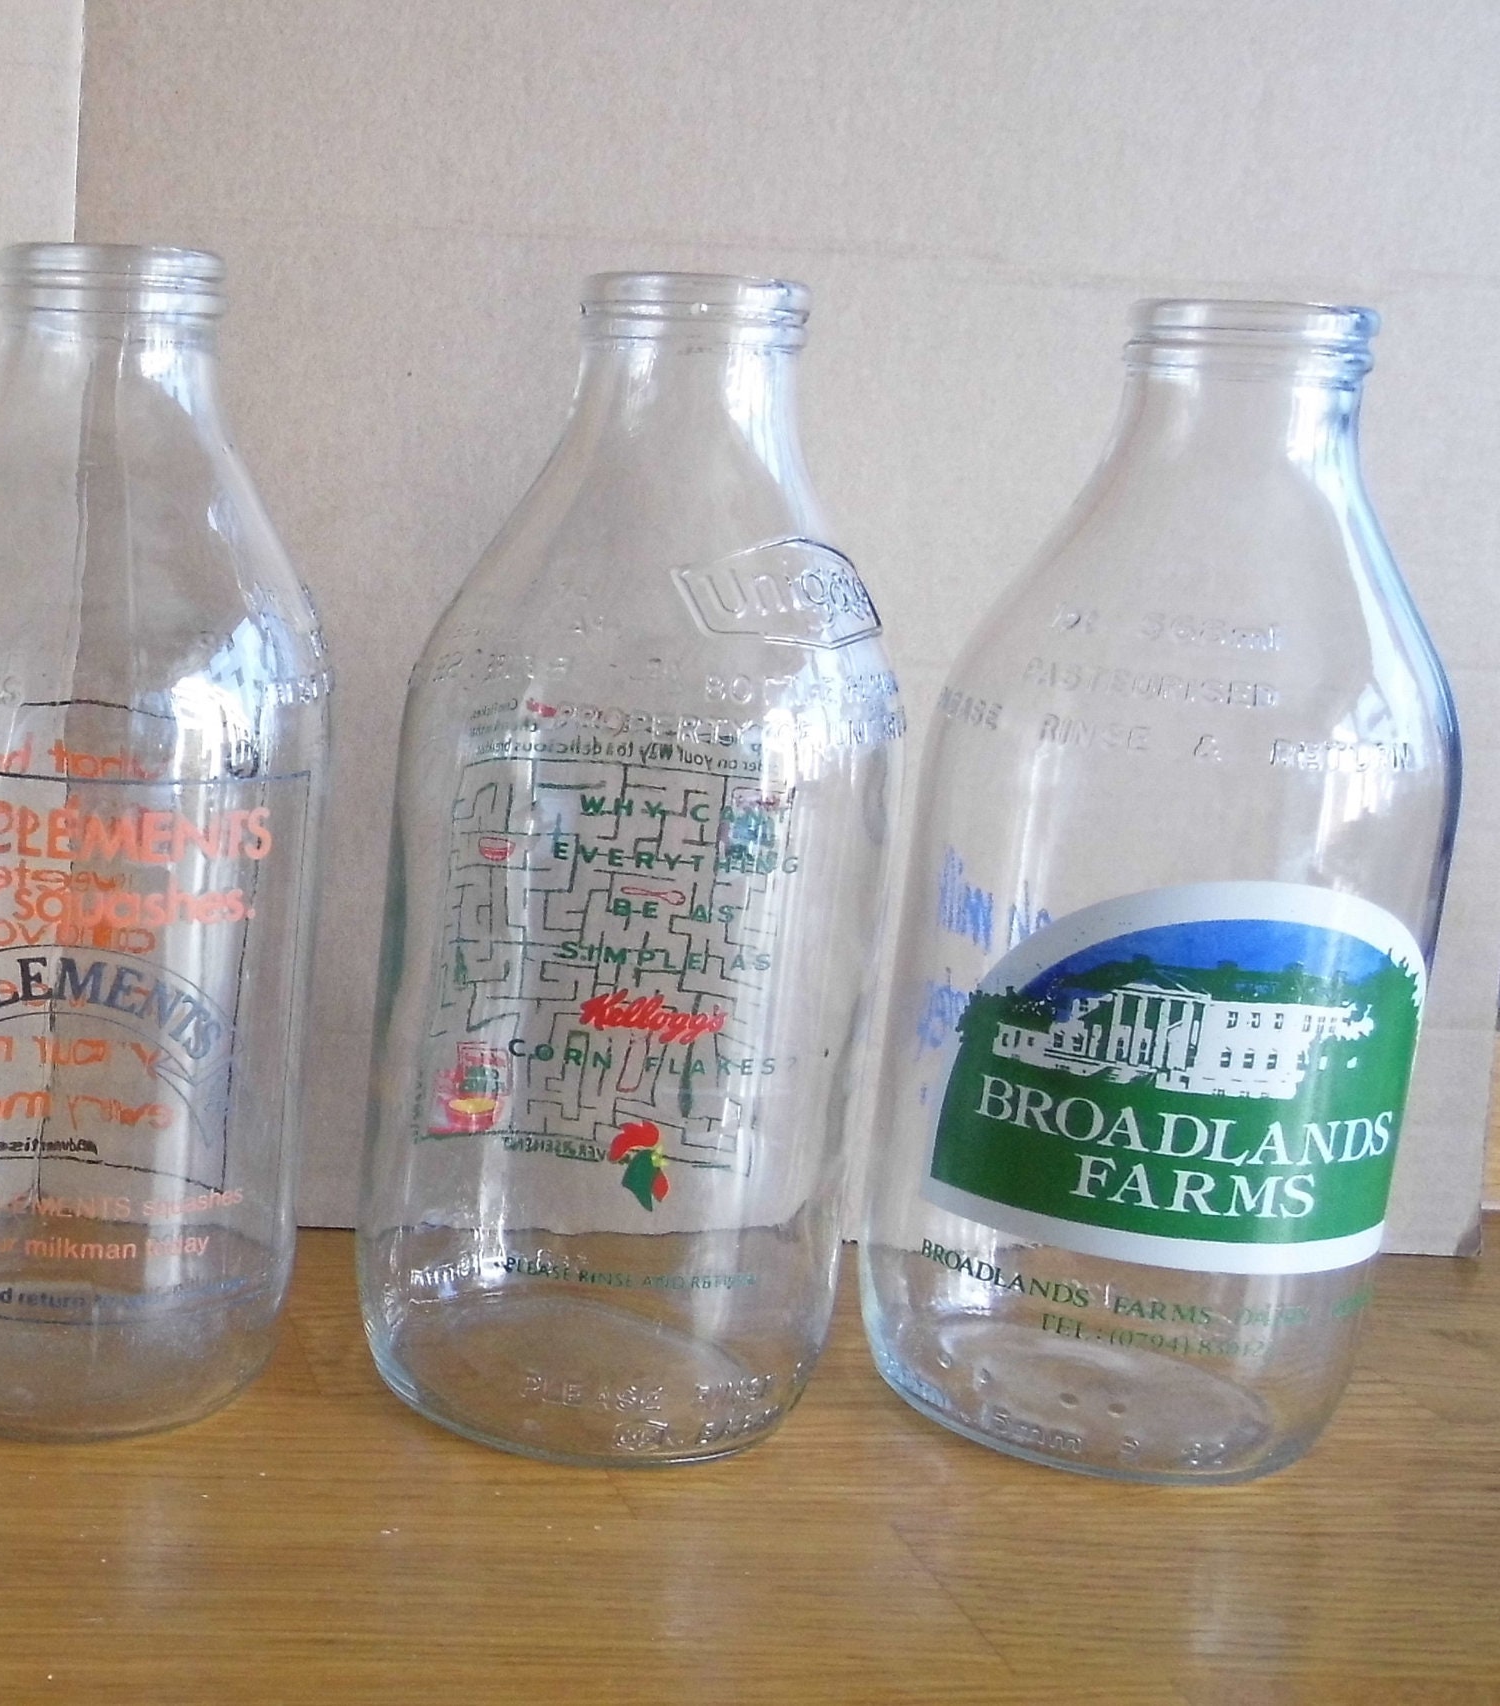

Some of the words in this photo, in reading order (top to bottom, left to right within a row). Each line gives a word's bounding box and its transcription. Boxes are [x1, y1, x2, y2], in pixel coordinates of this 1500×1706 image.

[580, 794, 666, 818] WHY
[553, 841, 799, 875] EVERYTHING
[13, 875, 256, 931] squashes.
[612, 897, 660, 919] BE
[691, 904, 735, 924] AS
[561, 941, 706, 970] SIMPLE
[730, 949, 772, 971] AS
[579, 988, 728, 1045] Kellogg's
[508, 1038, 613, 1070] CORN
[975, 1074, 1393, 1168] BROADLANDS
[1069, 1153, 1317, 1219] FARMS
[25, 1235, 137, 1261] milkman
[145, 1233, 211, 1261] today
[504, 1255, 571, 1282] PLEASE
[578, 1268, 634, 1288] RINSE
[643, 1275, 684, 1291] AND
[921, 1237, 1090, 1309] BROADLANDS
[1112, 1295, 1214, 1325] FARMS
[17, 1286, 88, 1311] return
